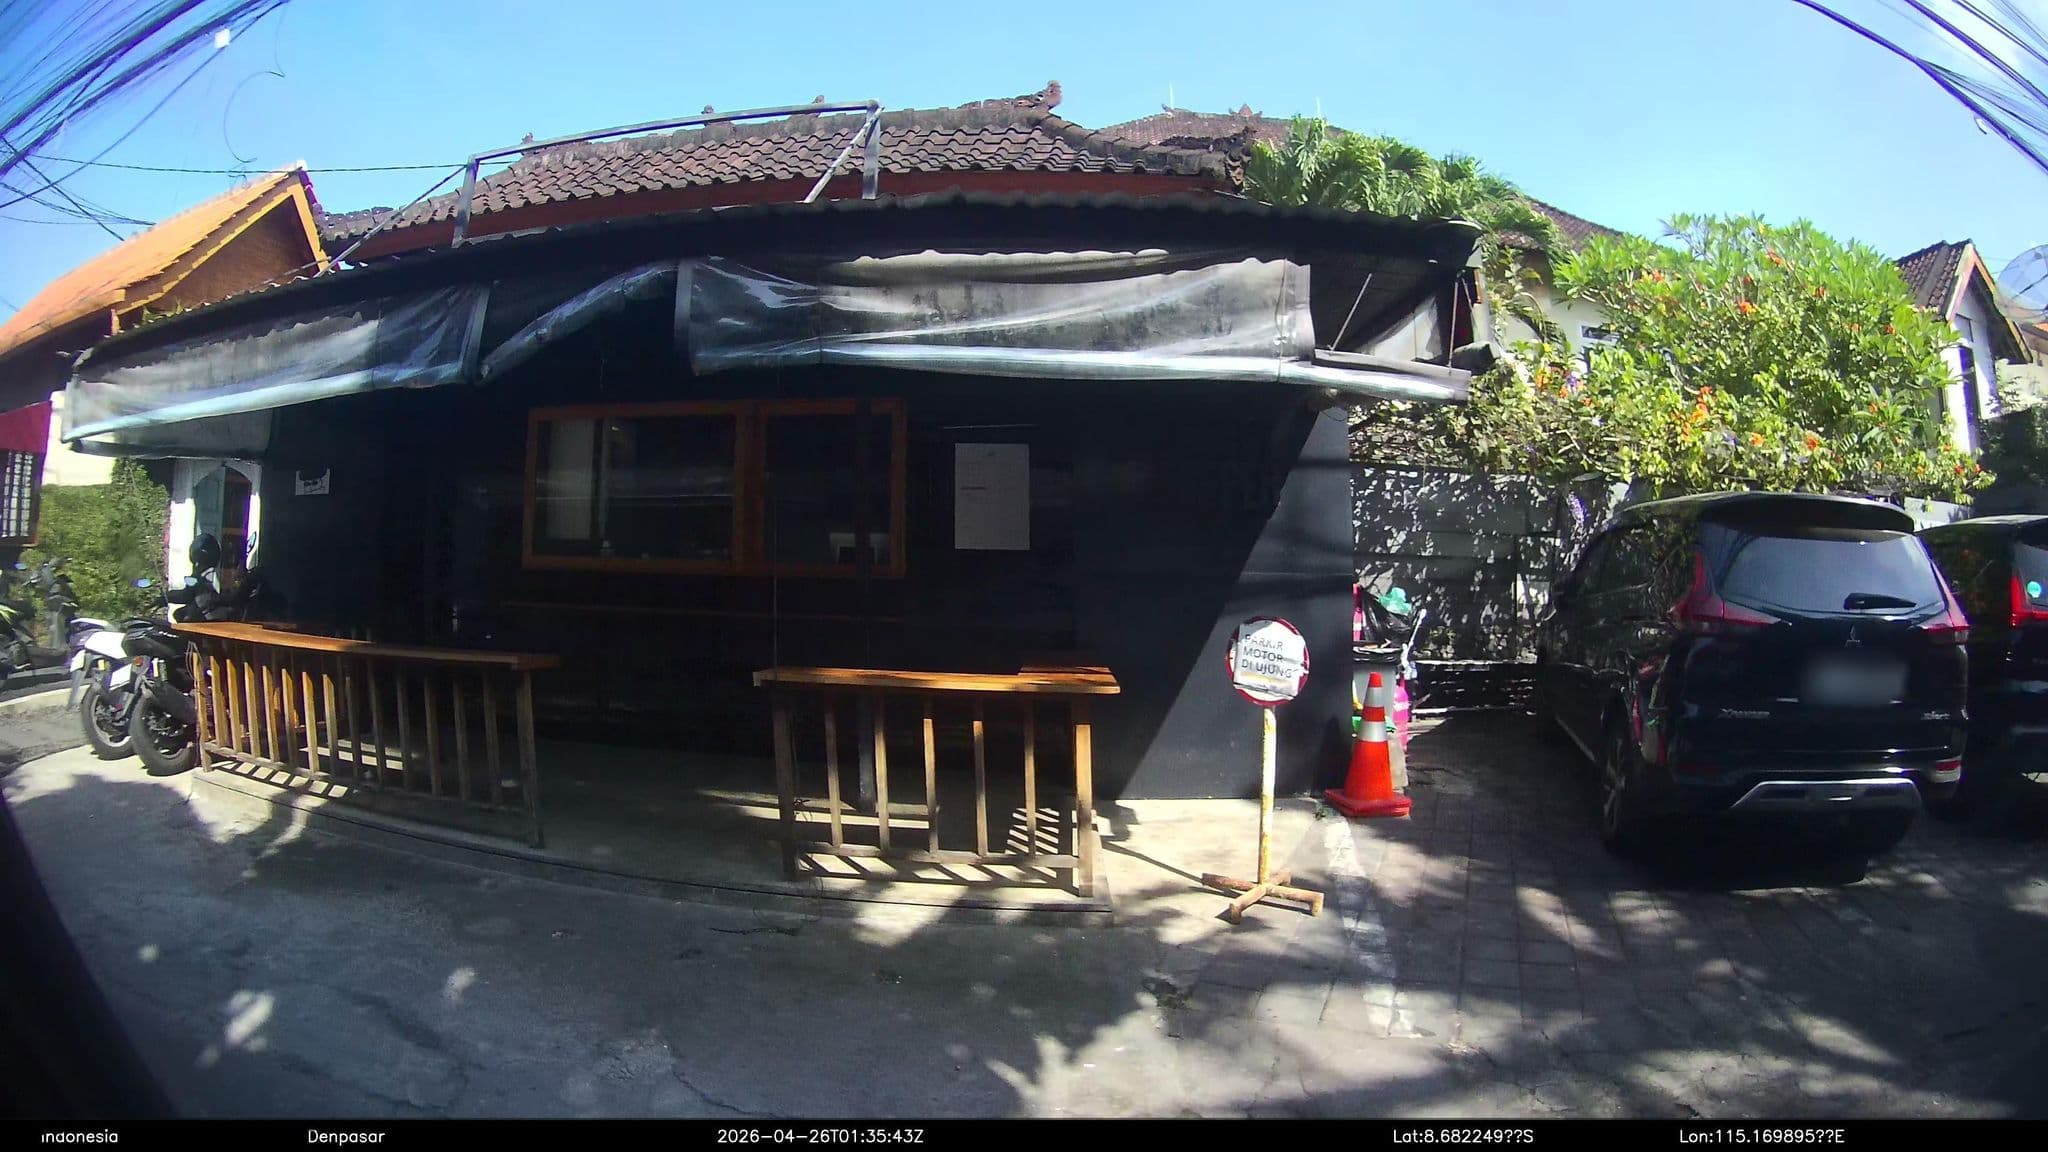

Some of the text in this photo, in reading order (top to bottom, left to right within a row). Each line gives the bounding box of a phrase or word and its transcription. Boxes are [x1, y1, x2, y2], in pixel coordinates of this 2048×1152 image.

[1244, 633, 1283, 651] PARKIR
[1243, 646, 1284, 663] MOTOR
[1241, 659, 1293, 679] DI UJUNG
